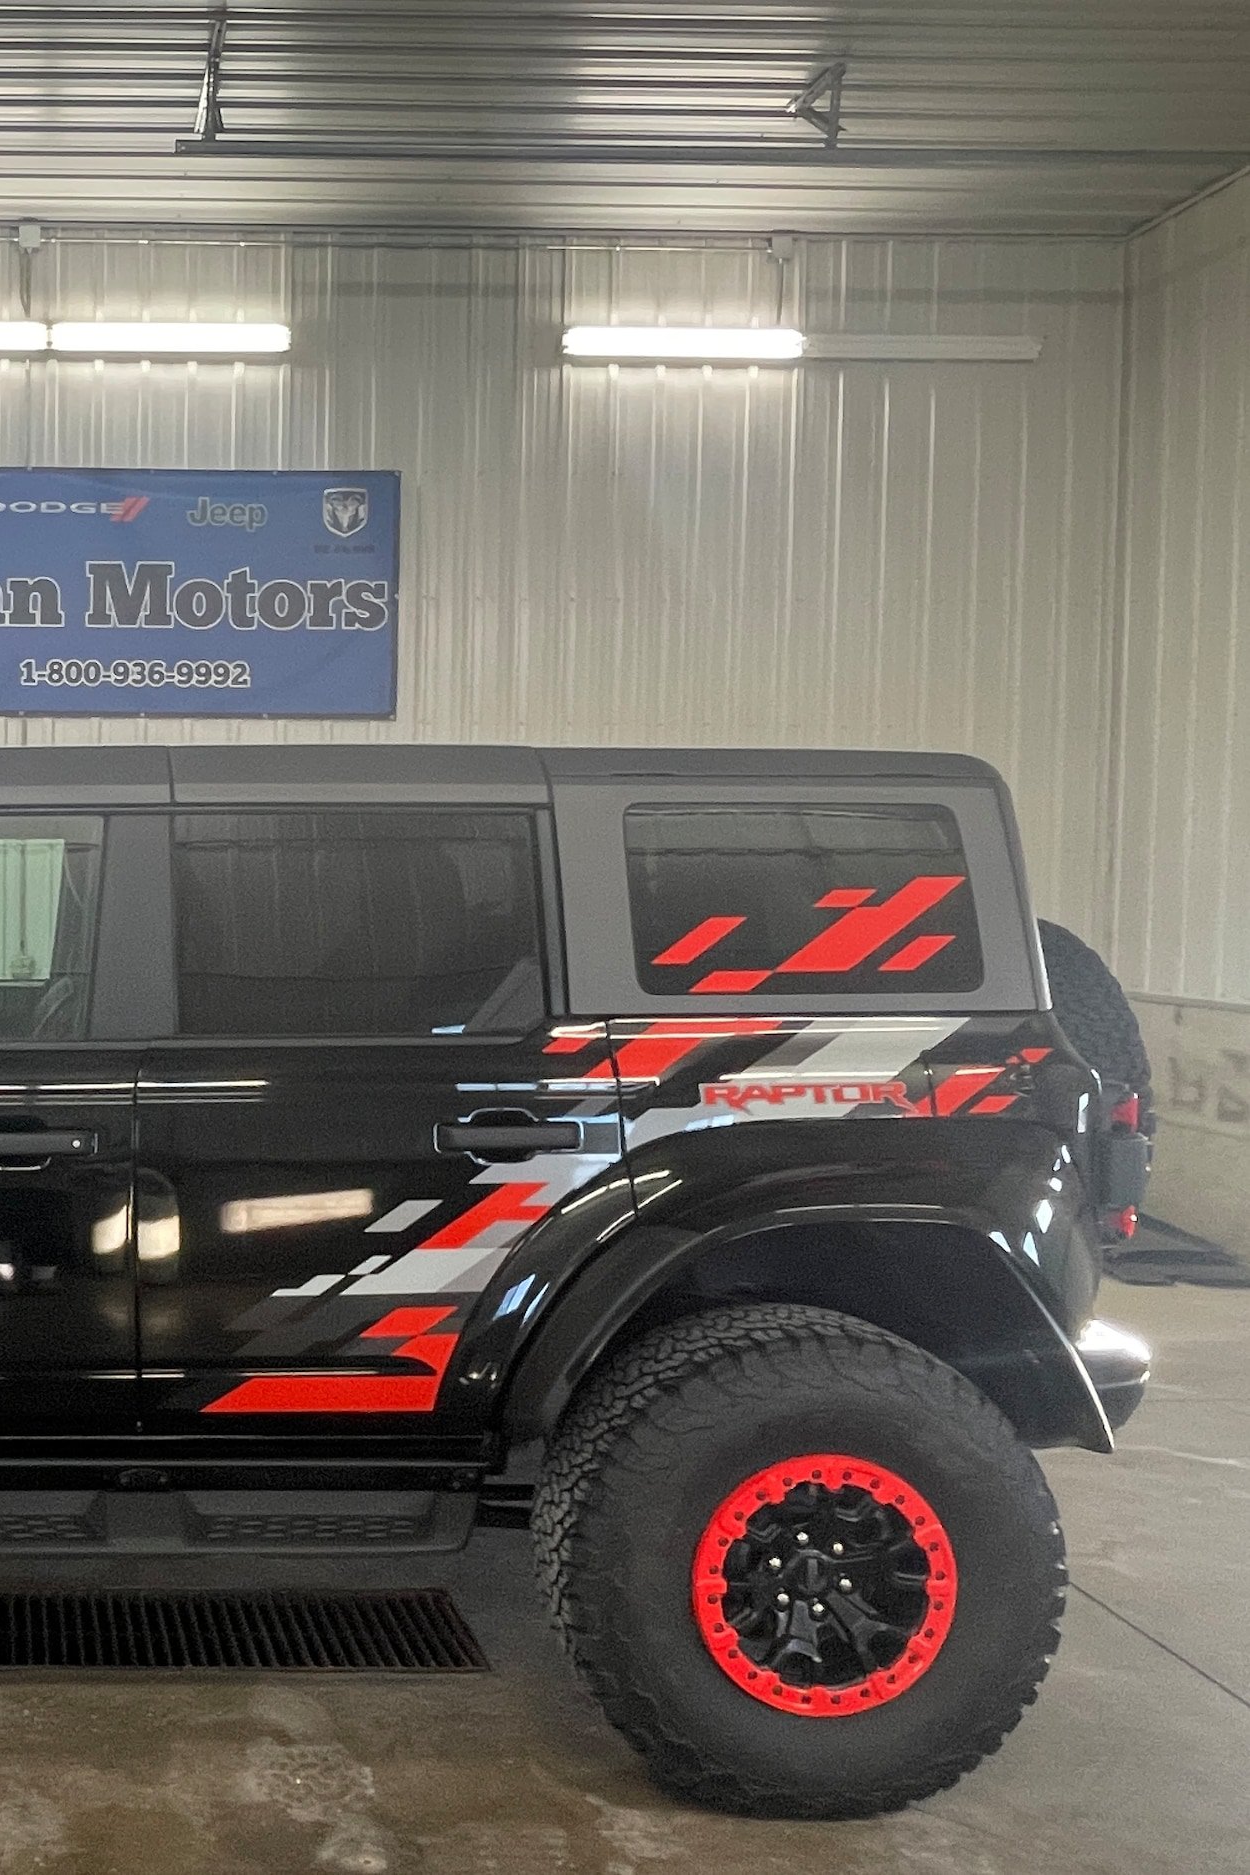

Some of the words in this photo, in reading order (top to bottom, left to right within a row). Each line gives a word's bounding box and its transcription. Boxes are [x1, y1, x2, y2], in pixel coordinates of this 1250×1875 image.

[187, 497, 268, 532] Jeep
[85, 560, 389, 631] Motors
[19, 657, 252, 689] 1-800-936-9992
[700, 1082, 914, 1115] RAPTOR
